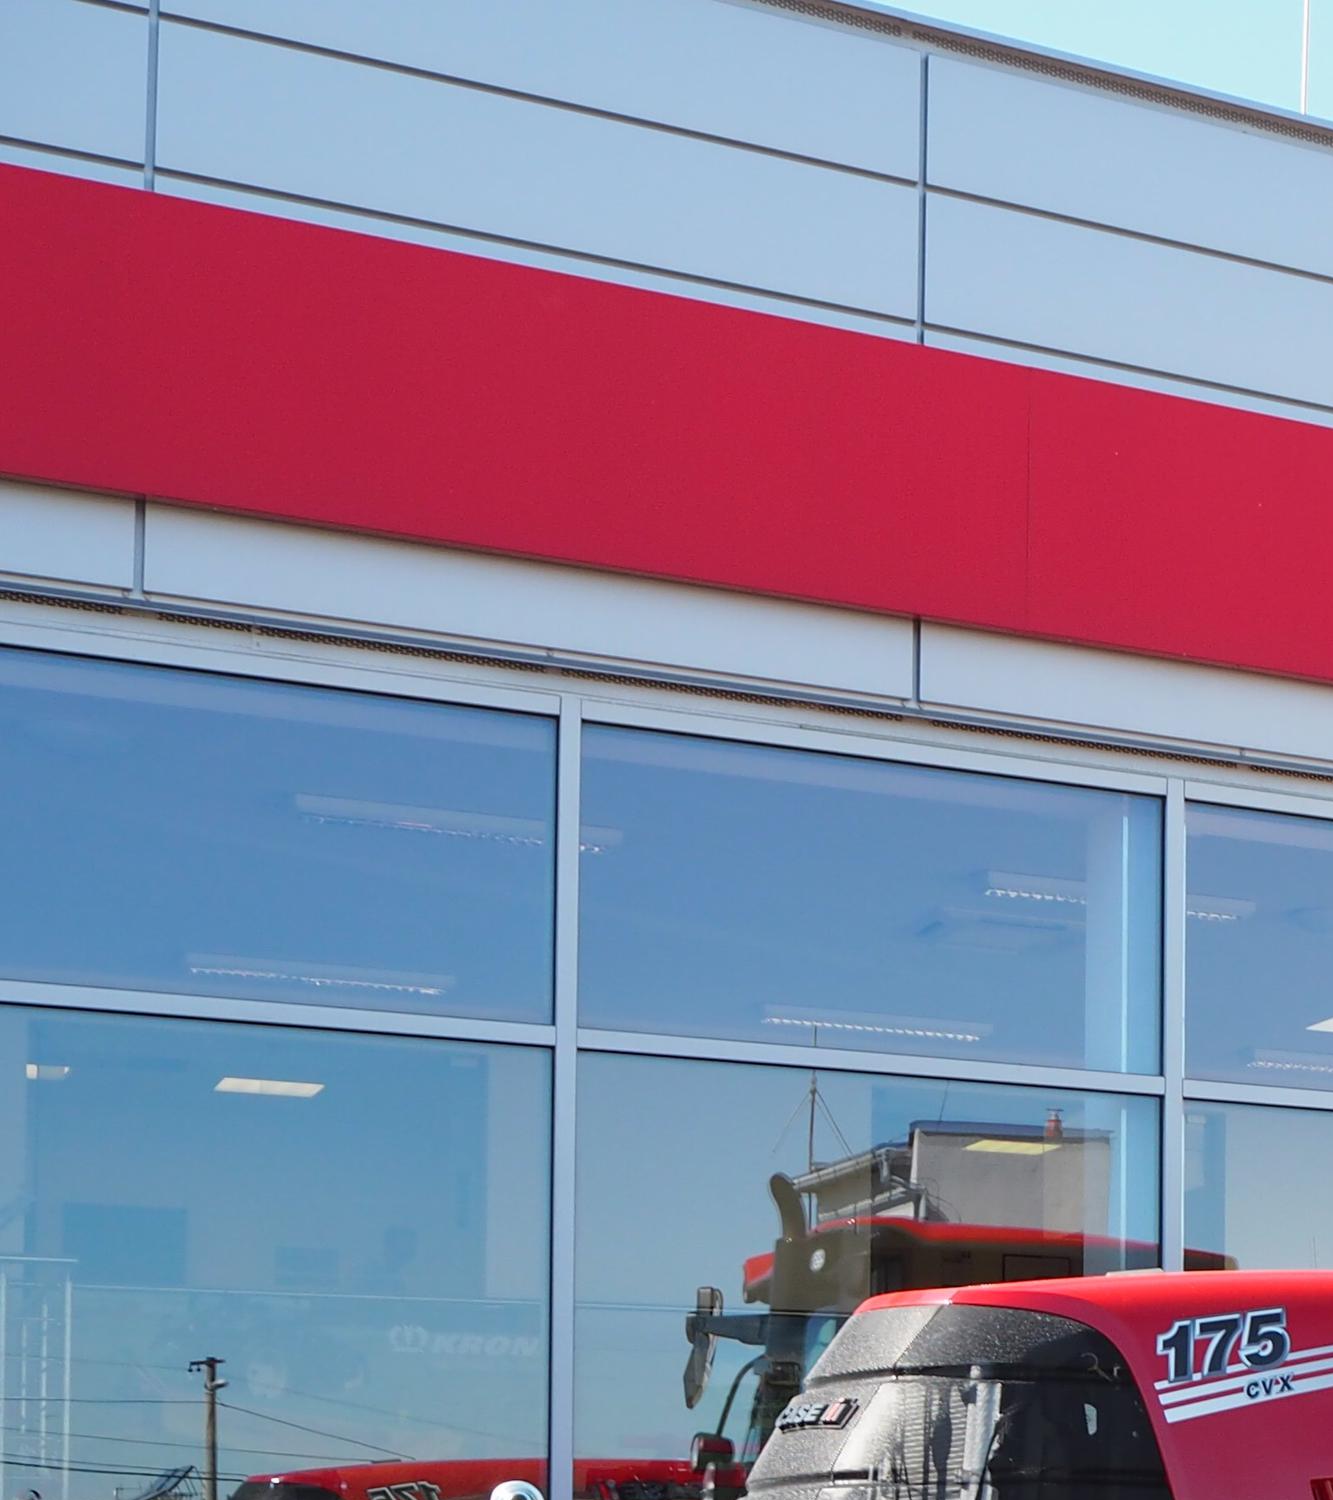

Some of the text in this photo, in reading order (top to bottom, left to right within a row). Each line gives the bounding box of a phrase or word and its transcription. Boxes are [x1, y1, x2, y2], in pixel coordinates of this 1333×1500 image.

[431, 1333, 540, 1356] KRON
[1156, 1306, 1290, 1383] 175
[1244, 1374, 1296, 1400] CVX
